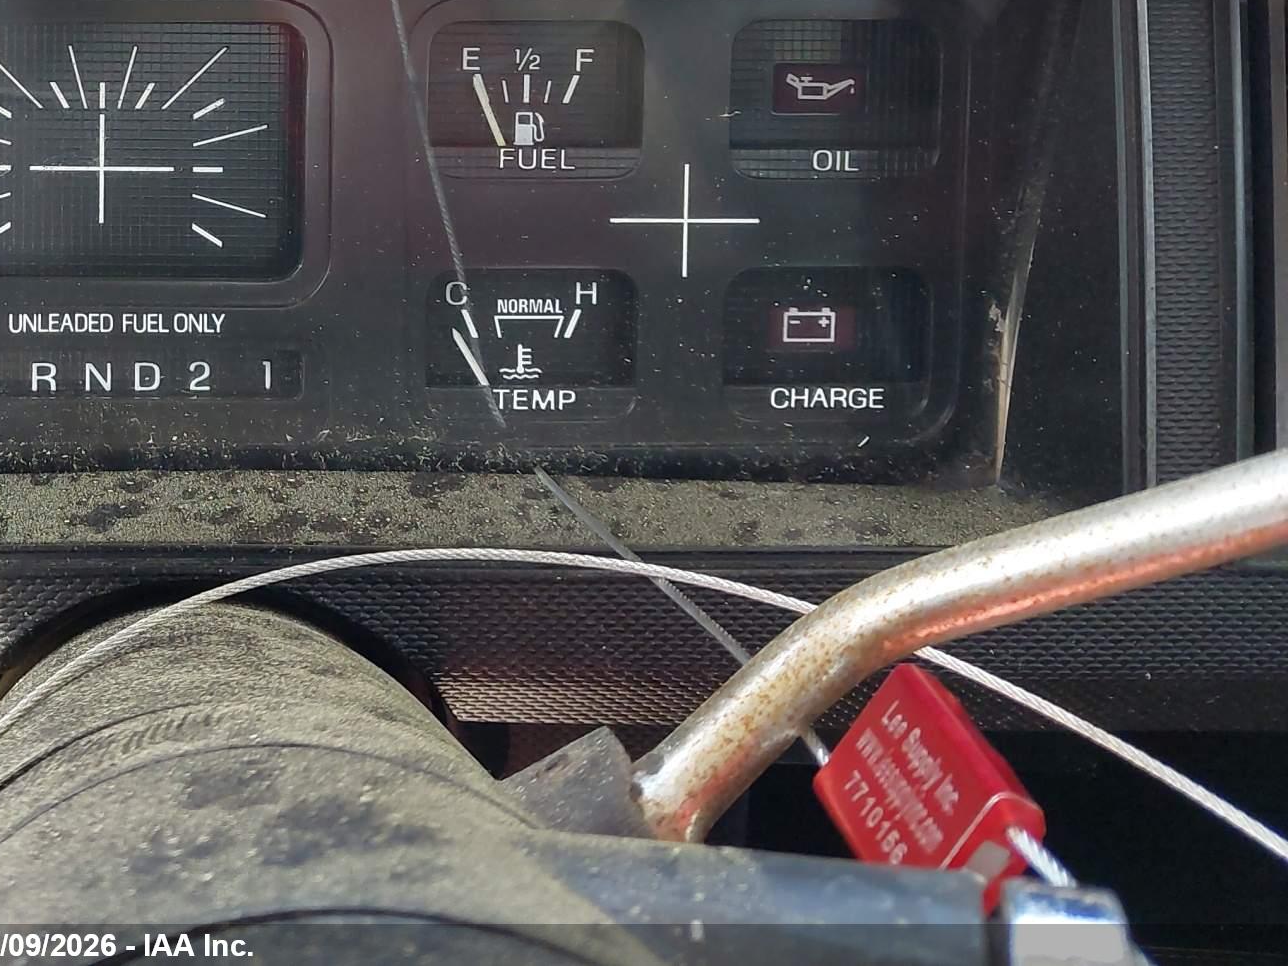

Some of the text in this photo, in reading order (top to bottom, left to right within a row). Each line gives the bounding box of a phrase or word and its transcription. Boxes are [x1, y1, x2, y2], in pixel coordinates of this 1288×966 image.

[462, 48, 480, 70] E
[576, 49, 594, 71] F
[498, 148, 575, 169] FUEL
[813, 151, 859, 171] OIL
[446, 282, 467, 305] C
[576, 283, 596, 304] H
[497, 298, 562, 314] NORMAL
[9, 313, 225, 333] UNLEADED FUEL ONLY
[32, 363, 56, 391] R
[85, 363, 111, 391] N
[134, 363, 161, 391] D
[189, 362, 211, 391] 2
[262, 361, 271, 390] 1
[493, 390, 576, 410] TEMP
[770, 388, 884, 409] CHARGE
[882, 700, 908, 738] Lee
[902, 727, 943, 791] Supply
